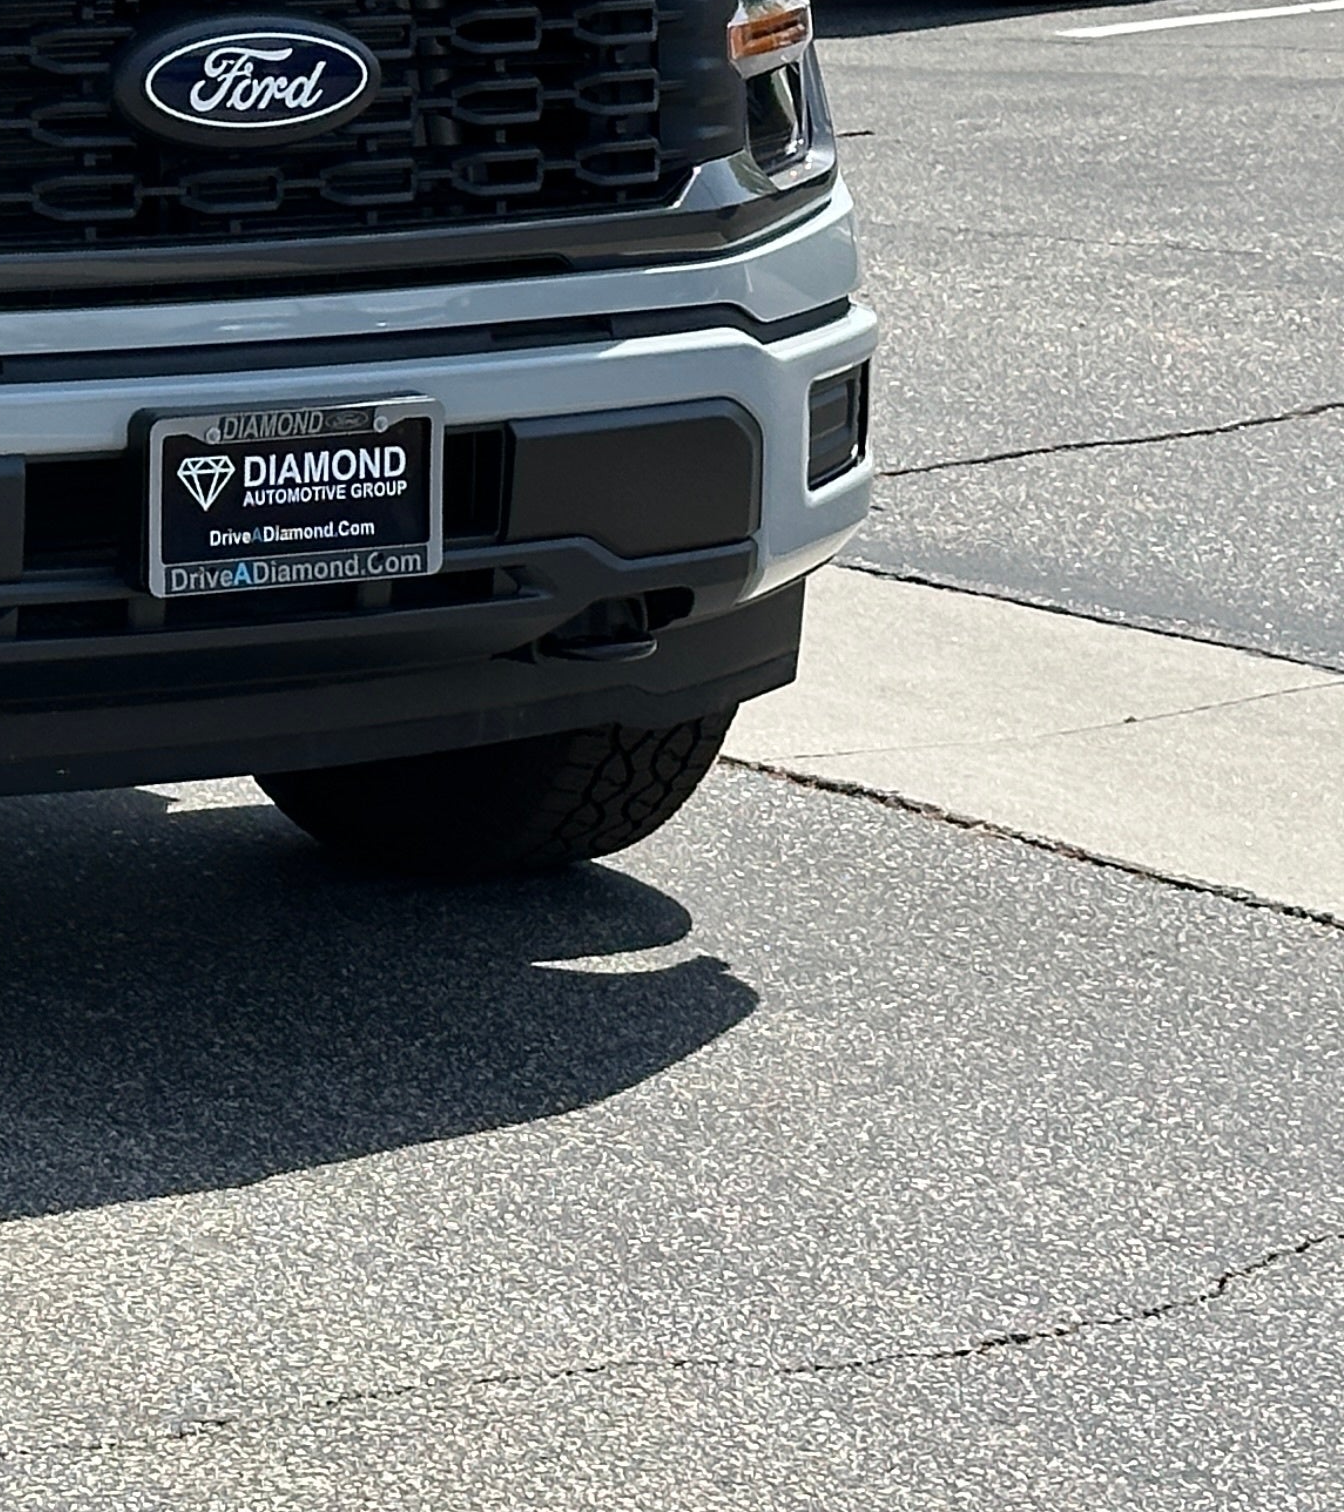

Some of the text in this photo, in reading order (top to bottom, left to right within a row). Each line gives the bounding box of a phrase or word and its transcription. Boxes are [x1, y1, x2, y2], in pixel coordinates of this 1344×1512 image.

[189, 46, 327, 112] Ford
[221, 410, 324, 440] DIAMOND
[242, 445, 407, 488] DIAMOND
[242, 480, 408, 508] AUTOMOTIVE GROUP
[209, 520, 375, 547] DriveADiamond.Com
[170, 551, 423, 592] DriveADiamond.Com
